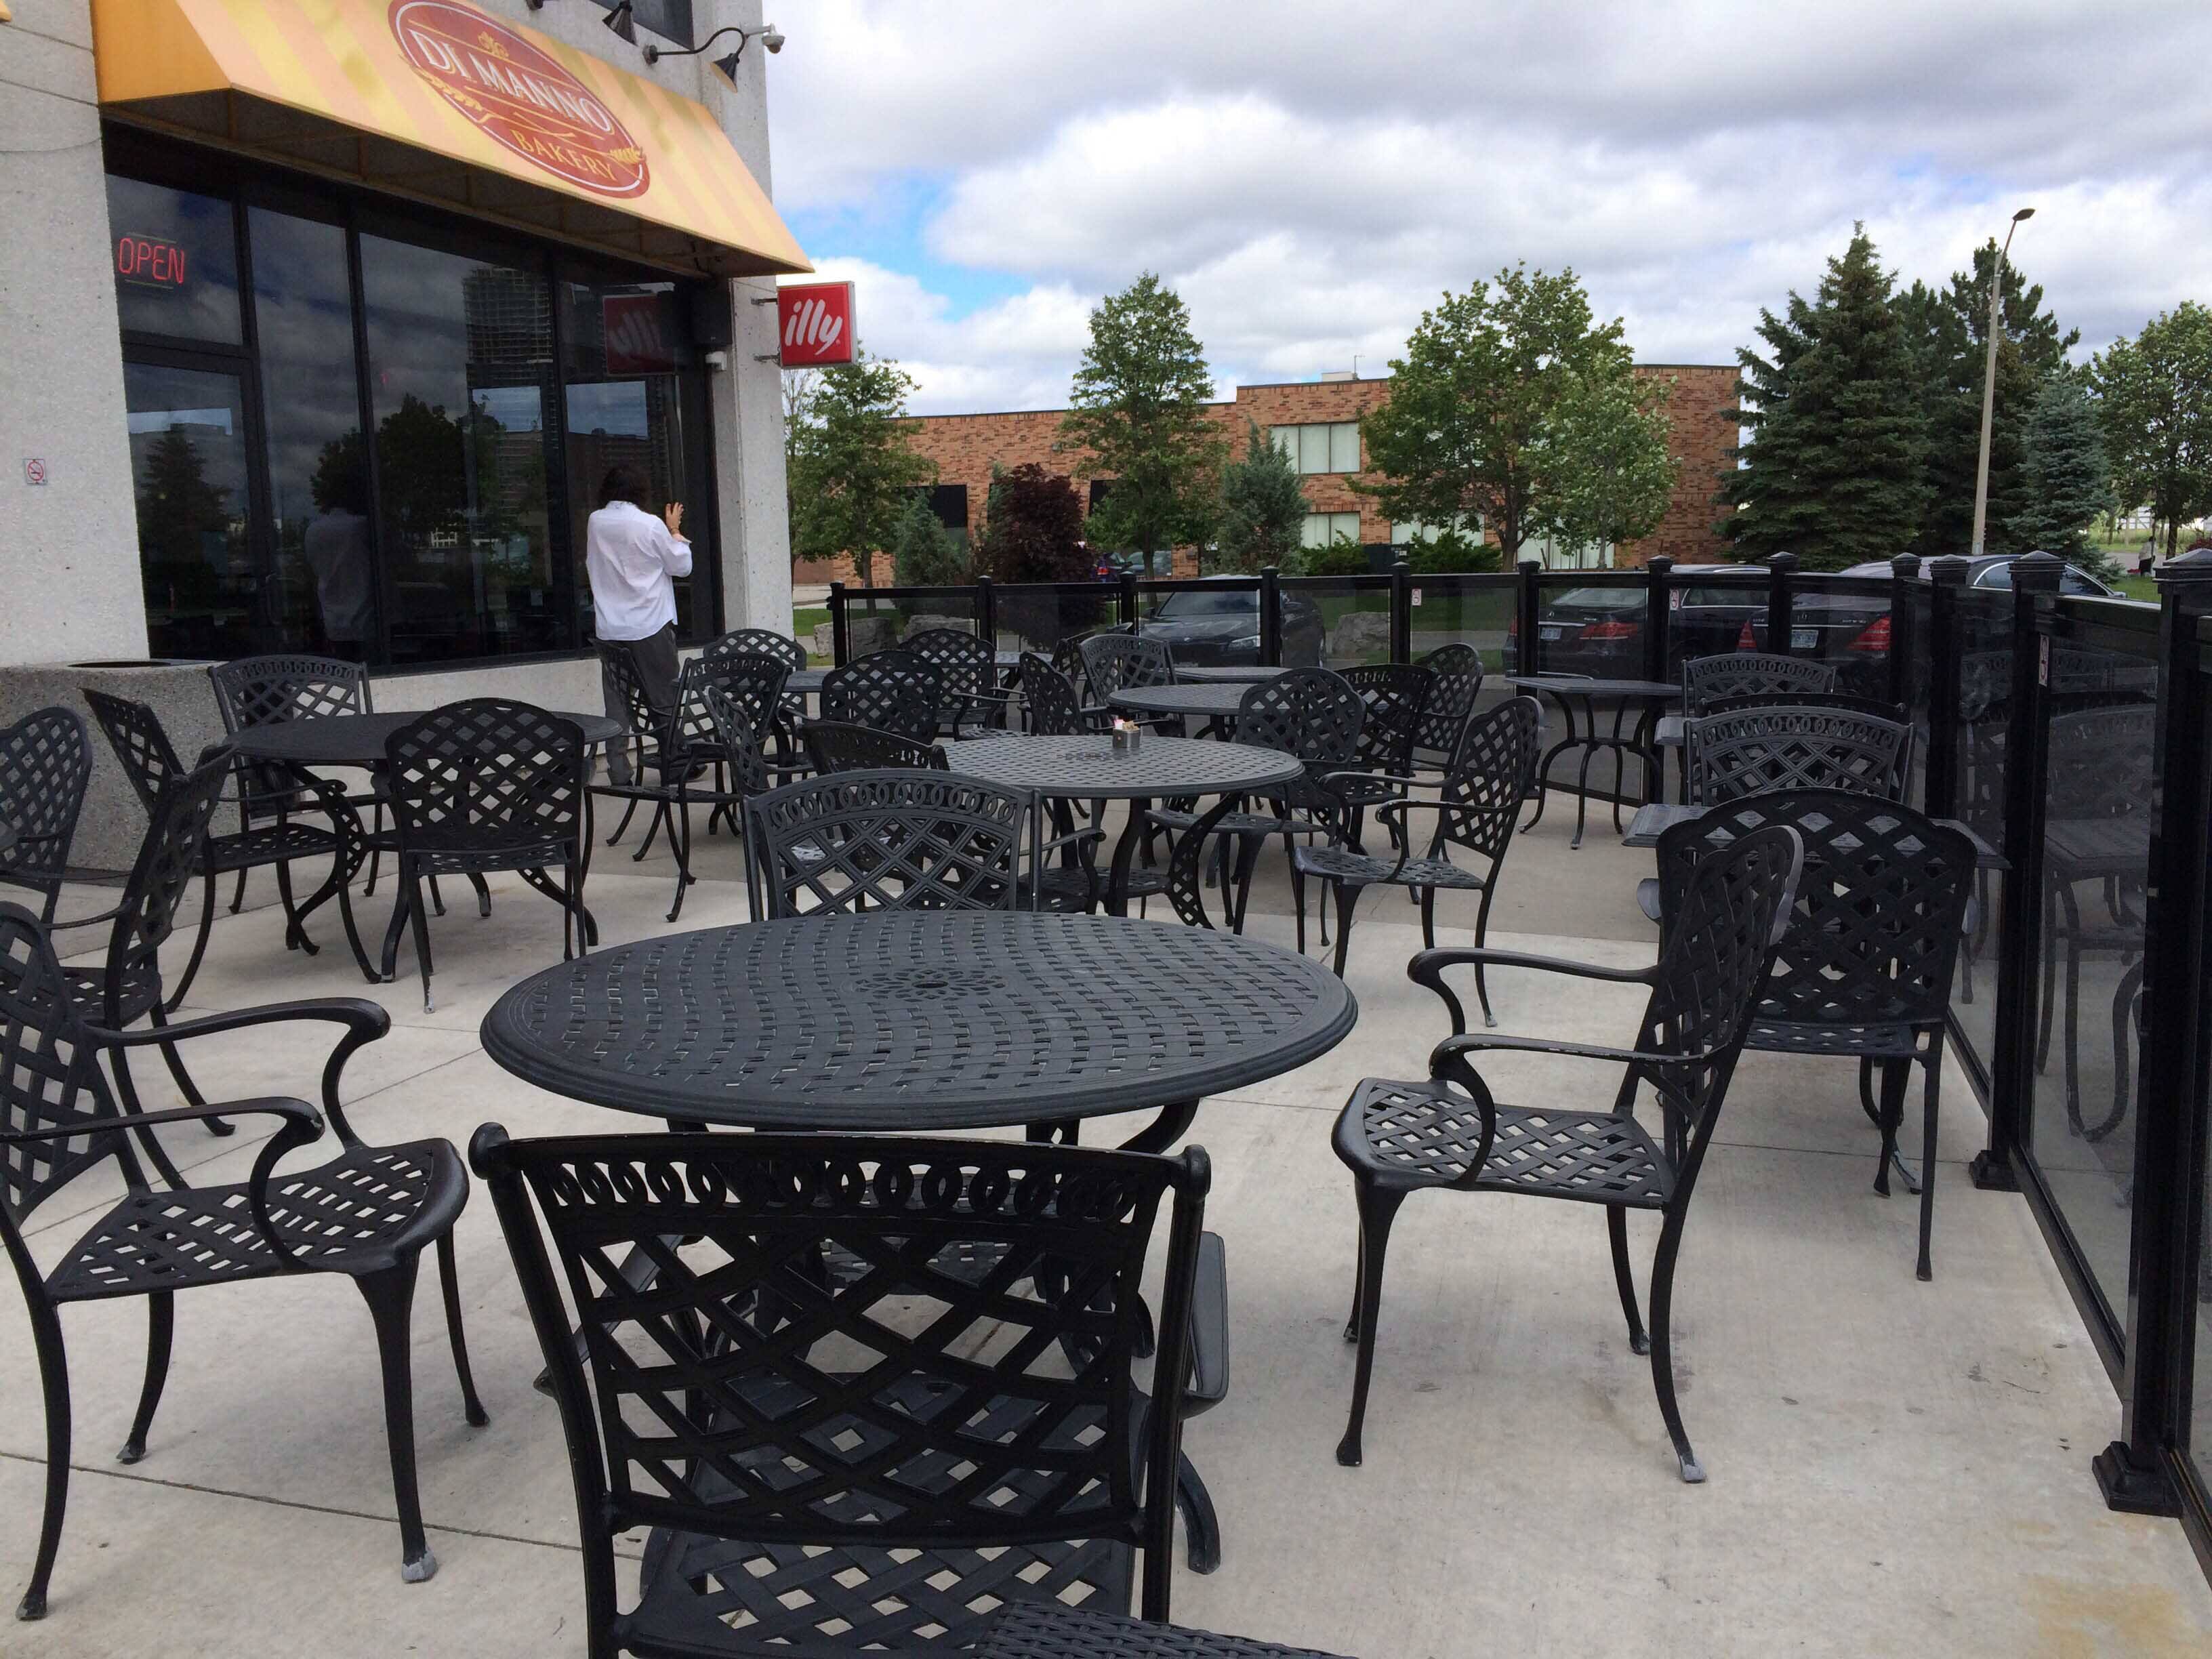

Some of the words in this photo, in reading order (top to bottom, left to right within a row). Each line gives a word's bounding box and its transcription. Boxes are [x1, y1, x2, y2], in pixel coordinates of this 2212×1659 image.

[409, 28, 476, 82] DI
[470, 54, 614, 134] MANNO
[510, 129, 618, 181] BAKERY
[119, 237, 185, 285] OPEN
[785, 298, 843, 356] illy
